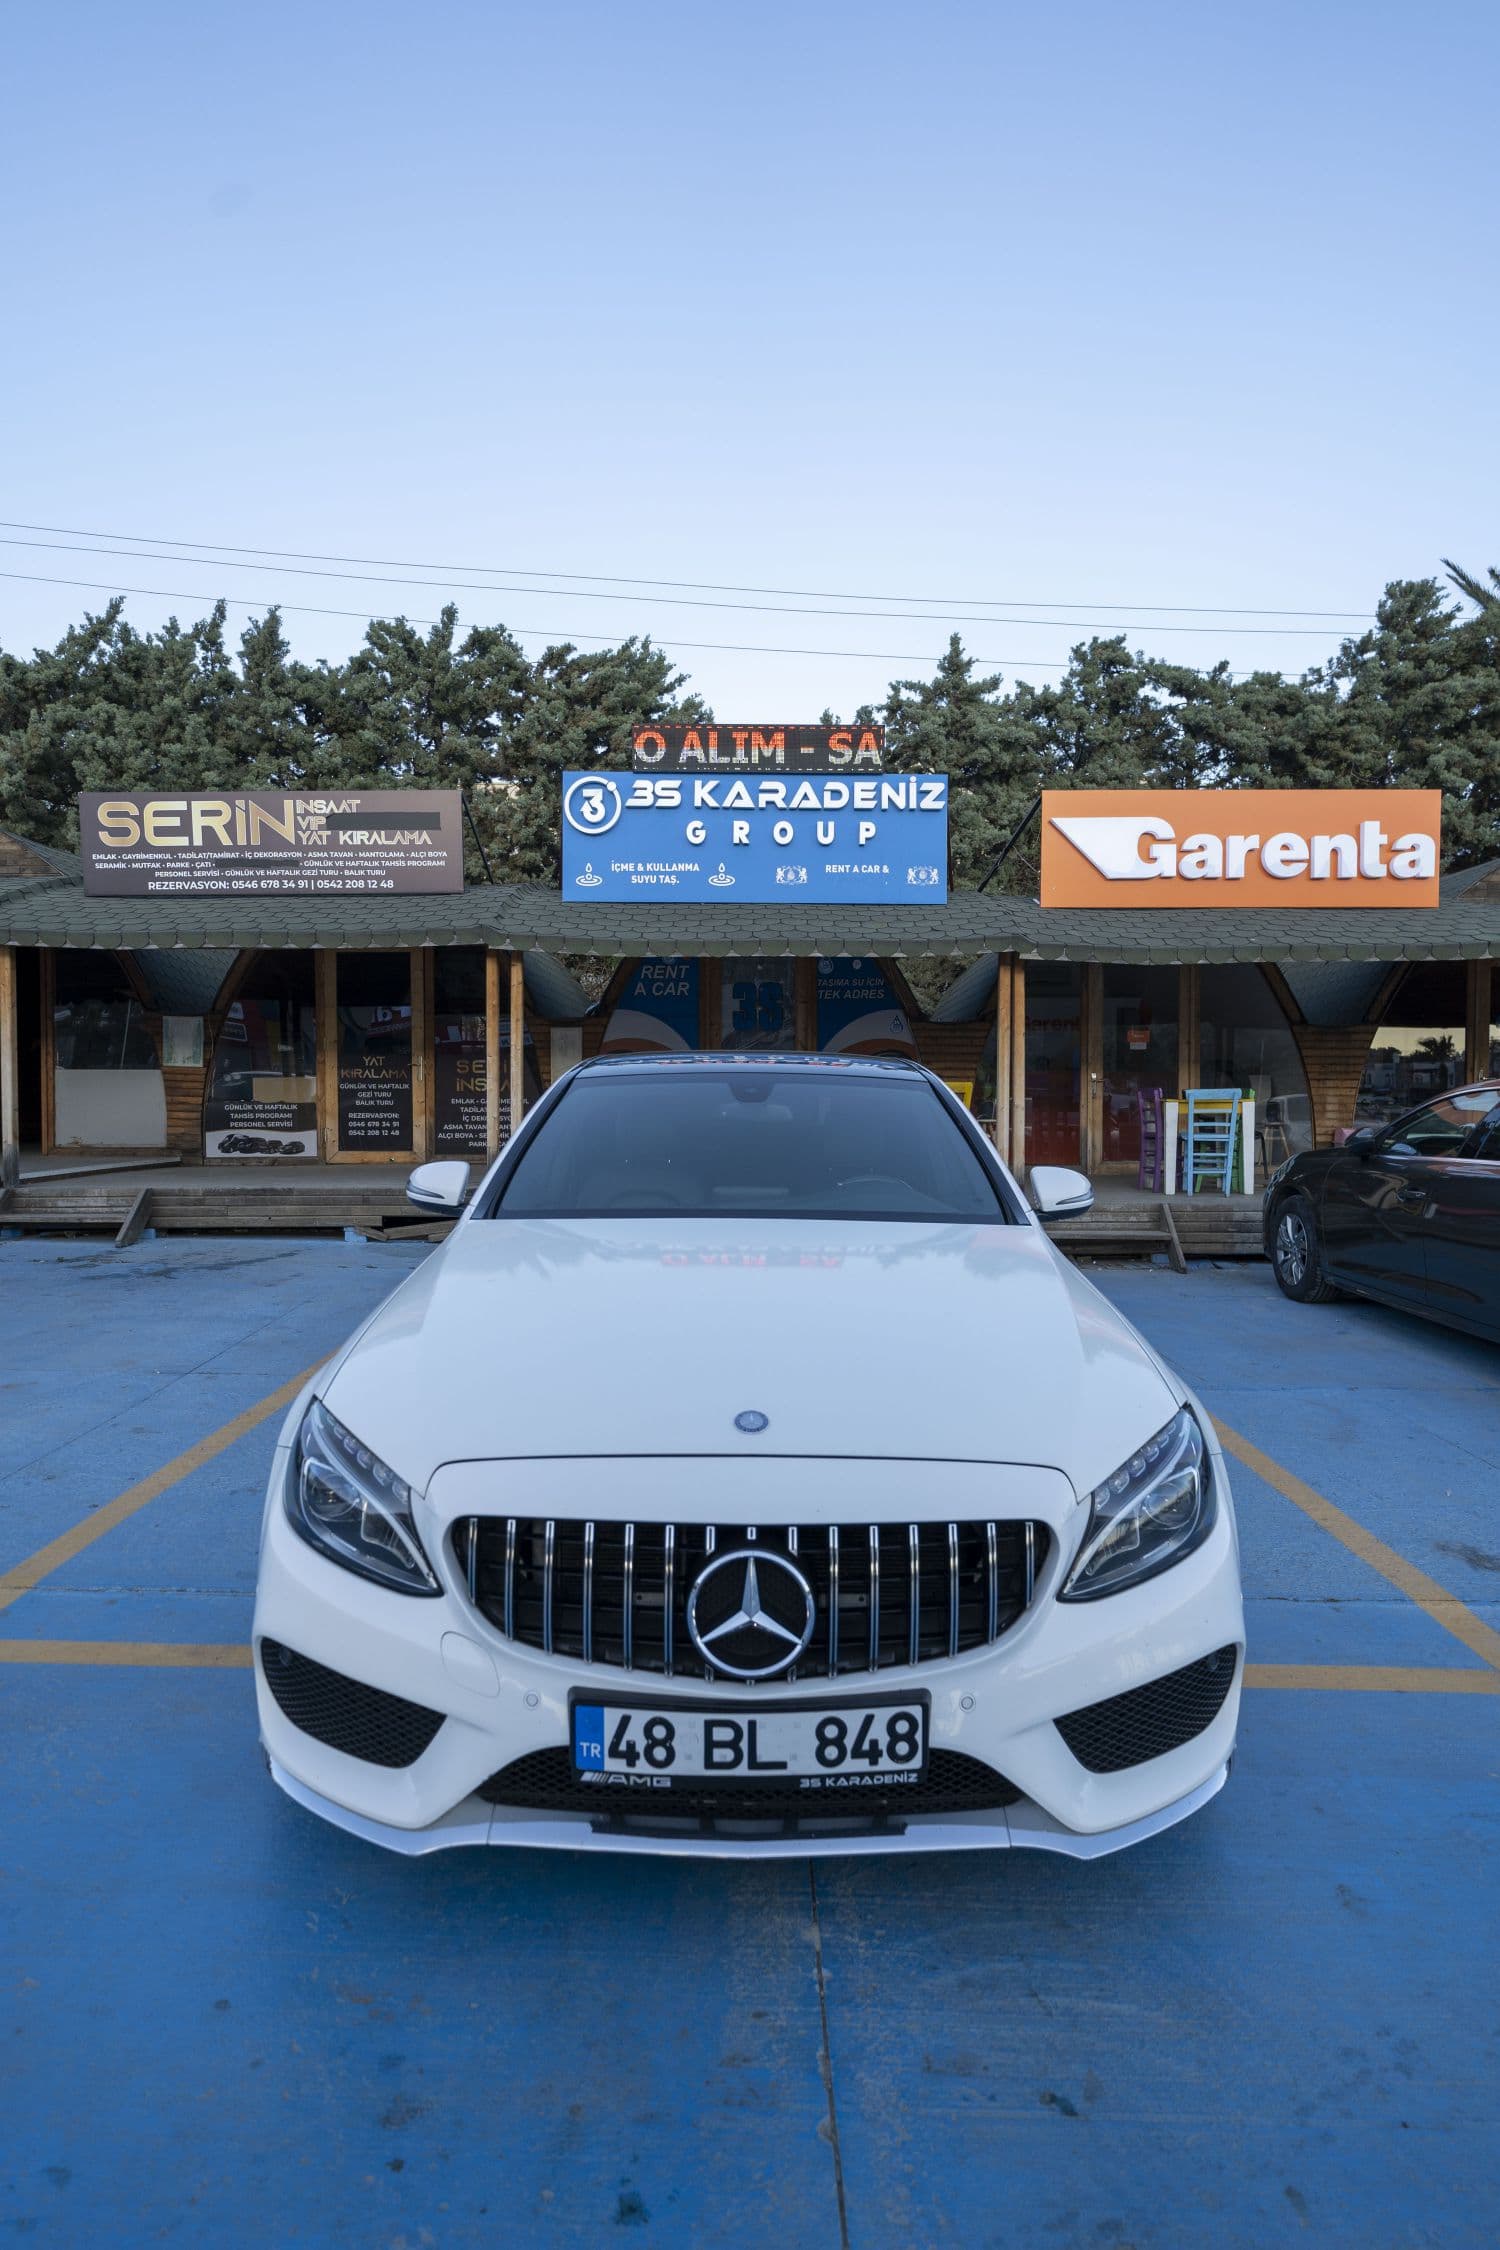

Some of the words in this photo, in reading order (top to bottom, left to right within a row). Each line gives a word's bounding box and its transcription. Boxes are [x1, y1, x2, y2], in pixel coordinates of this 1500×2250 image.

[634, 731, 666, 763] O
[678, 731, 785, 764] ALIM
[828, 731, 882, 765] SA
[625, 779, 682, 808] 3S
[694, 776, 946, 810] KARADENİZ
[97, 799, 295, 847] SERİN
[297, 831, 331, 845] YAT
[339, 830, 432, 845] KIRALAMA
[686, 820, 877, 846] GROUP
[1049, 816, 1436, 880] Garenta
[122, 852, 172, 860] GAYRİMENKUL
[178, 851, 240, 860] TADİLAT/TAMİRAT
[245, 851, 253, 860] İÇ
[411, 851, 427, 859] ALÇI
[94, 861, 127, 869] SERAMİK
[195, 861, 212, 870] ÇATI
[303, 859, 334, 867] GÜNLÜK
[381, 859, 406, 867] TAHSİS
[611, 860, 635, 872] İÇME
[637, 863, 644, 872] &
[646, 863, 700, 872] KULLANMA
[825, 864, 851, 873] RENT
[852, 865, 859, 873] A
[861, 865, 880, 873] CAR
[882, 865, 890, 874] &
[193, 869, 220, 877] SERVİSİ
[225, 869, 254, 877] GÜNLÜK
[266, 869, 301, 877] HAFTALIK
[302, 868, 318, 876] GEZİ
[148, 881, 229, 890] REZERVASYON:
[231, 880, 258, 890] 0546
[260, 880, 279, 889] 678
[282, 880, 296, 889] 34
[297, 880, 309, 889] 91
[316, 880, 343, 889] 0542
[345, 880, 365, 889] 208
[367, 880, 378, 889] 12
[380, 880, 394, 889] 48
[631, 875, 657, 884] SUYU
[658, 875, 680, 885] TAŞ.
[641, 965, 690, 979] RENT
[634, 982, 647, 996] A
[652, 982, 690, 996] CAR
[817, 989, 841, 999] TEK
[843, 989, 886, 999] ADRES
[362, 1056, 385, 1066] YAT
[608, 1713, 676, 1769] 48
[703, 1719, 788, 1770] BL
[814, 1711, 920, 1769] 848
[580, 1742, 601, 1758] TR
[800, 1778, 822, 1789] 3S
[825, 1771, 919, 1788] KARADENİZ
